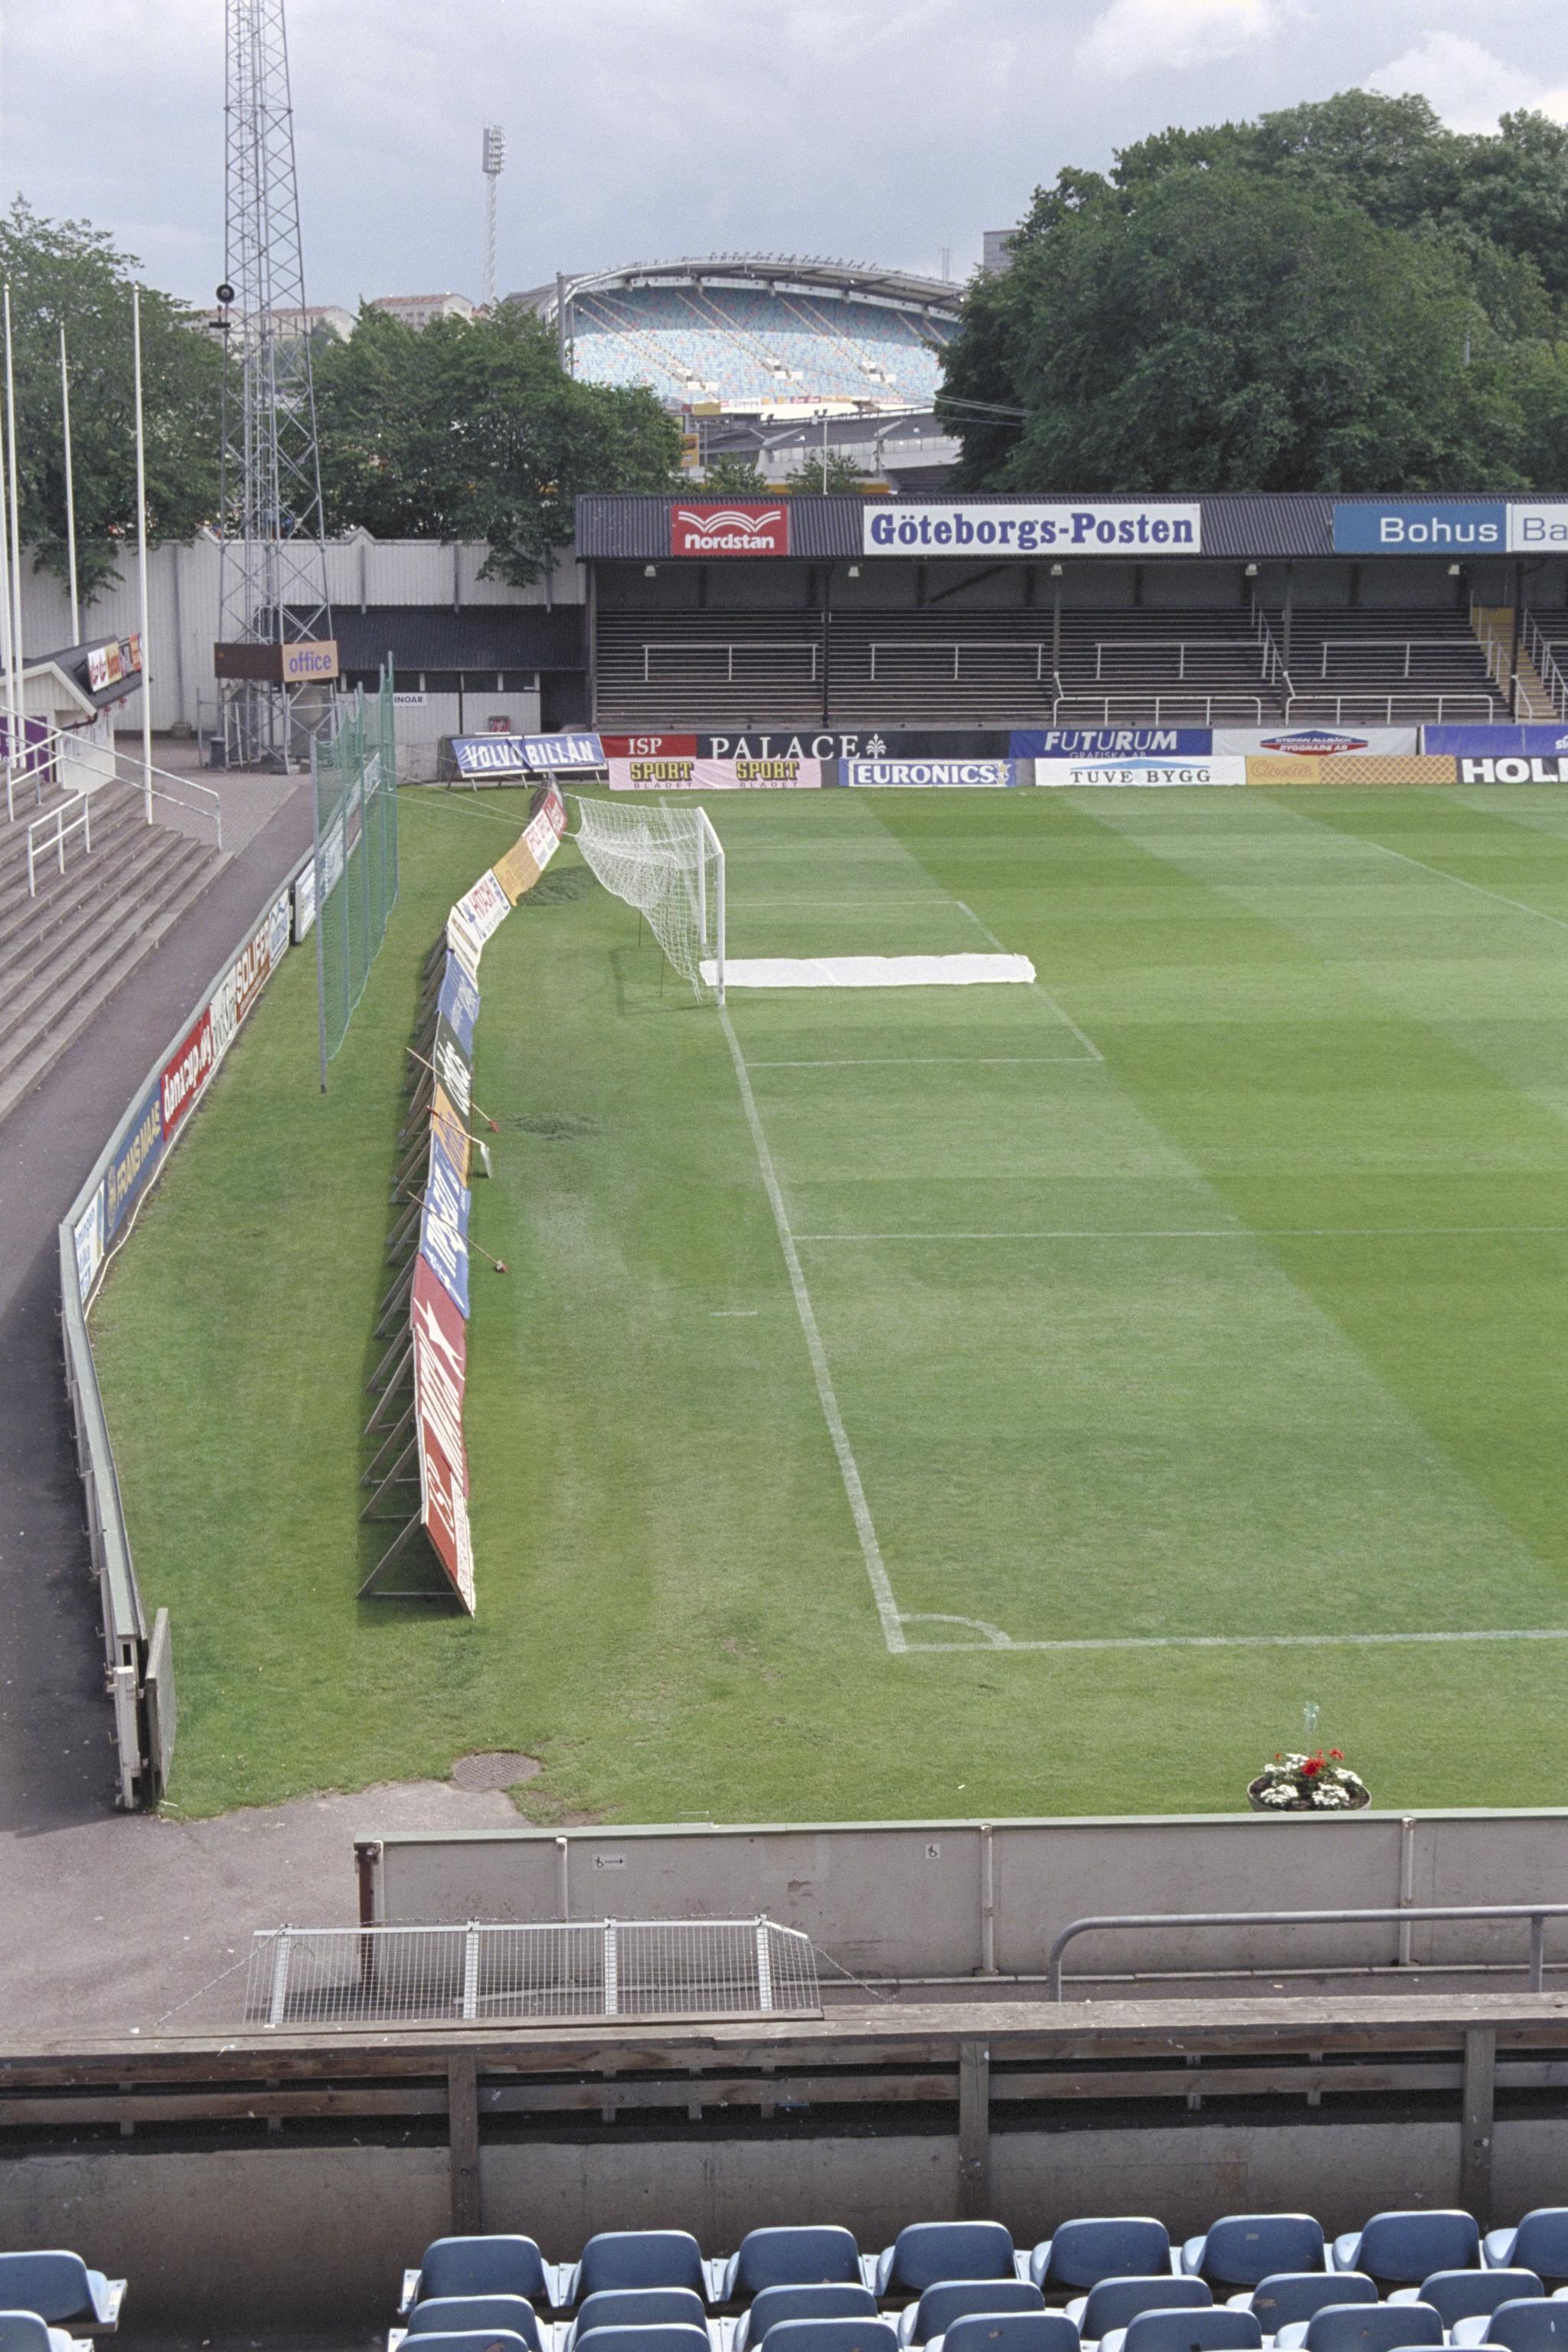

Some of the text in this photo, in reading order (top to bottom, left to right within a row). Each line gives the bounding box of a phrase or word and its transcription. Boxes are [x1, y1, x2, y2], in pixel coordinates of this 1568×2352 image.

[871, 513, 1194, 550] Göteborgs-Posten
[1380, 518, 1498, 542] Bohus
[289, 651, 332, 673] office
[524, 737, 595, 766] BILLÅN
[628, 738, 662, 755] ISP
[710, 735, 861, 760] PALACE
[1044, 730, 1178, 751] FUTURUM
[630, 760, 694, 782] SPORT
[736, 760, 800, 782] SPORT
[858, 765, 995, 784] EURONICS
[1070, 769, 1211, 783] TUVE BYGG
[426, 1452, 455, 1544] ISP
